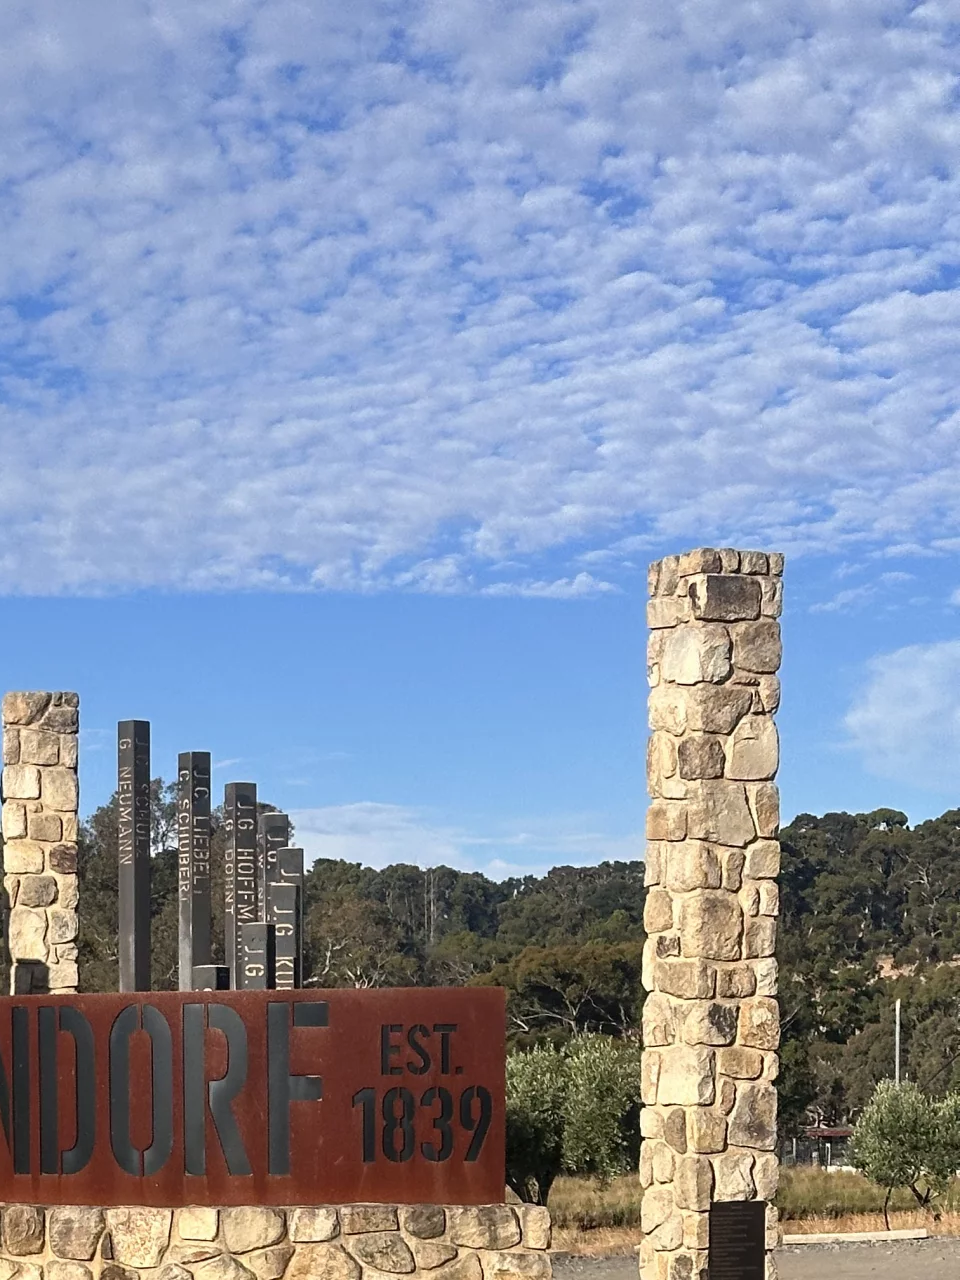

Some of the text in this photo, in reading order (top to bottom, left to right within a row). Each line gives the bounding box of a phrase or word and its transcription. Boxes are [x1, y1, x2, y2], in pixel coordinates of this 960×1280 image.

[118, 738, 132, 865] G. NEUMANN
[135, 783, 149, 859] SCHULZ
[178, 769, 191, 903] C. SCHUBERT
[236, 801, 255, 837] J.G.
[244, 945, 265, 985] J.G.
[380, 1023, 464, 1076] EST.
[352, 1085, 493, 1163] 1839
